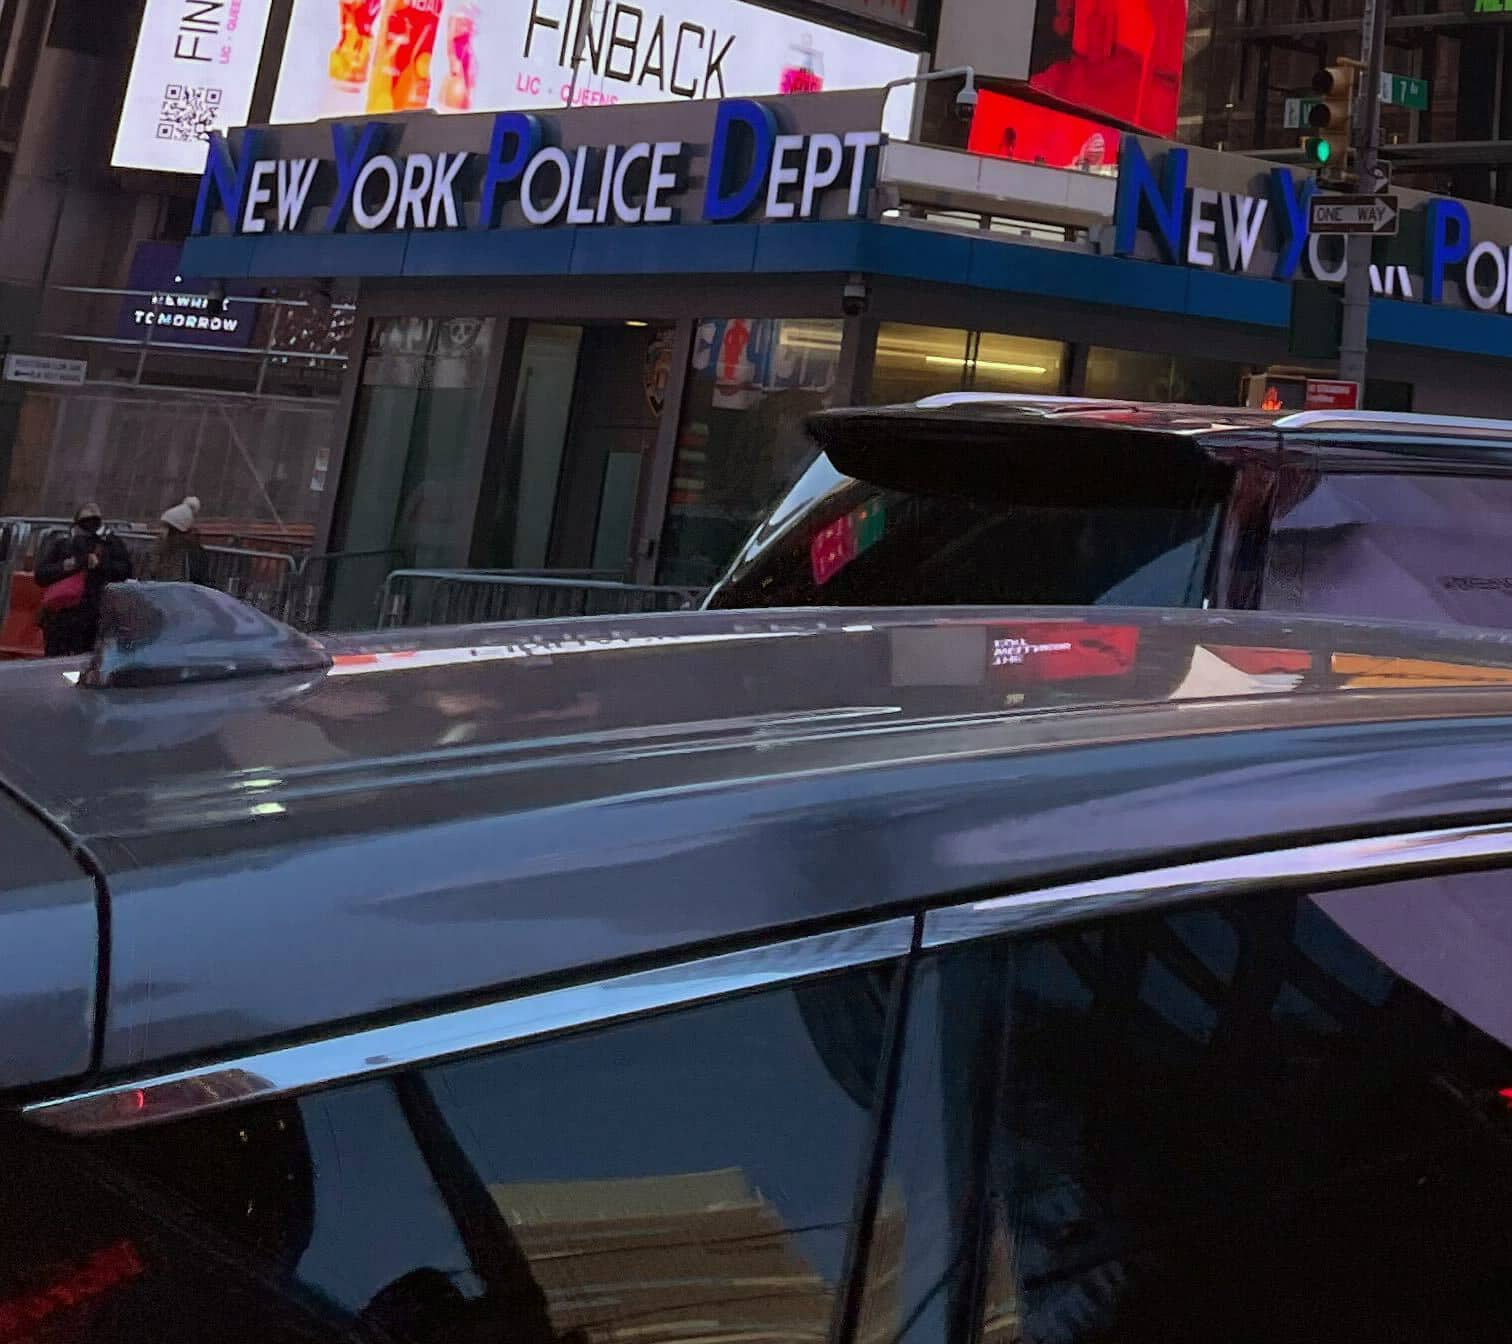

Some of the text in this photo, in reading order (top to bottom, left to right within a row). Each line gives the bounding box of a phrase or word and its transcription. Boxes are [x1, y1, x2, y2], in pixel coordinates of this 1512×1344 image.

[515, 72, 542, 96] LIC
[191, 98, 885, 235] NEW YORK POLICE DEPT
[1115, 134, 1268, 272] NEW
[1315, 207, 1386, 222] ONE WAY
[134, 310, 238, 332] TOMORROW
